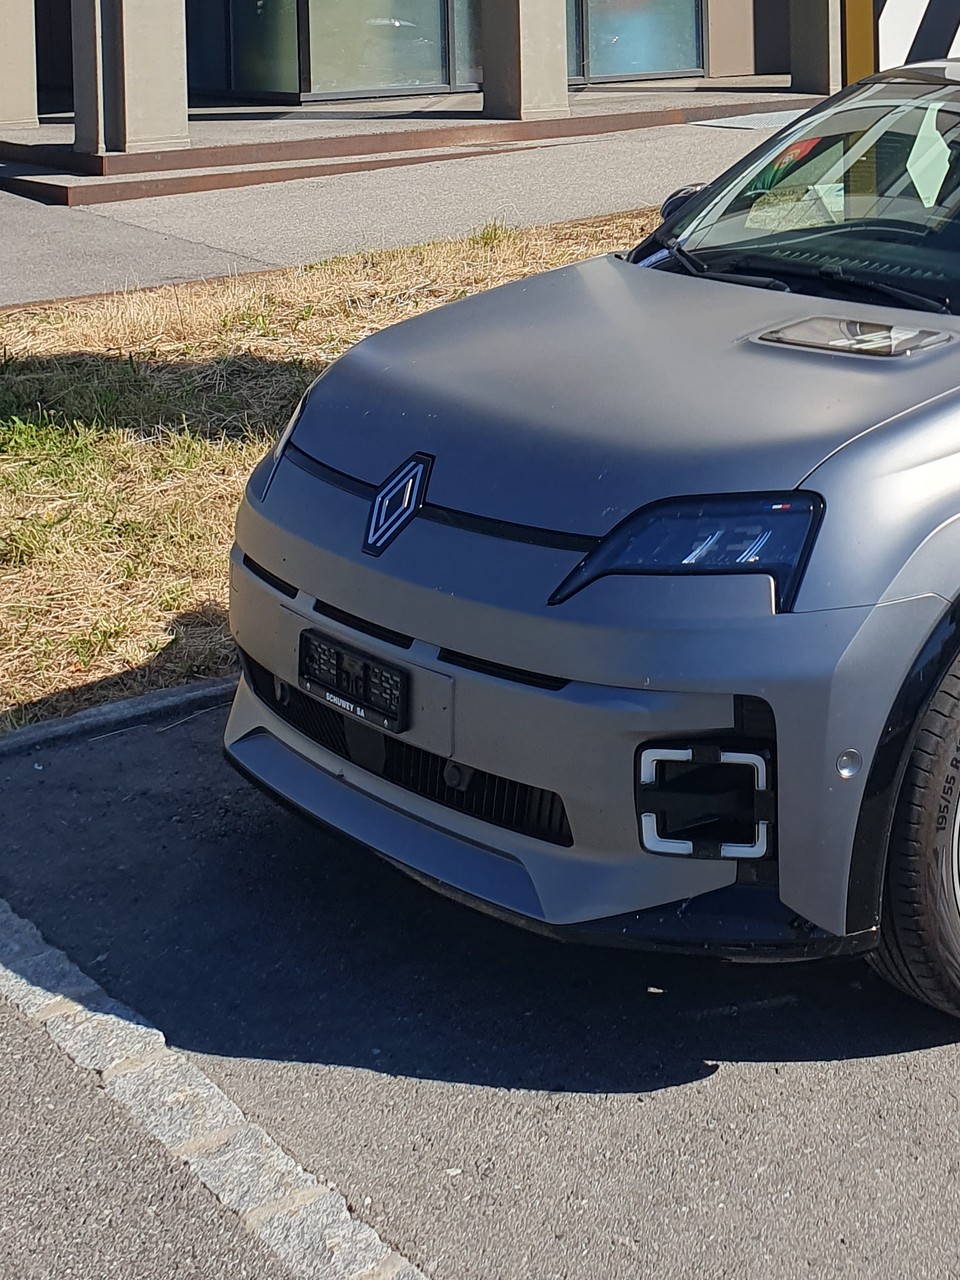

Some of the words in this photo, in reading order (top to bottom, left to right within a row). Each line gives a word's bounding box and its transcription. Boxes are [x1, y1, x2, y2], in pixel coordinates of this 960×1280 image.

[325, 691, 354, 712] SCHUWEY
[356, 706, 365, 718] SA
[936, 775, 956, 833] 195/55
